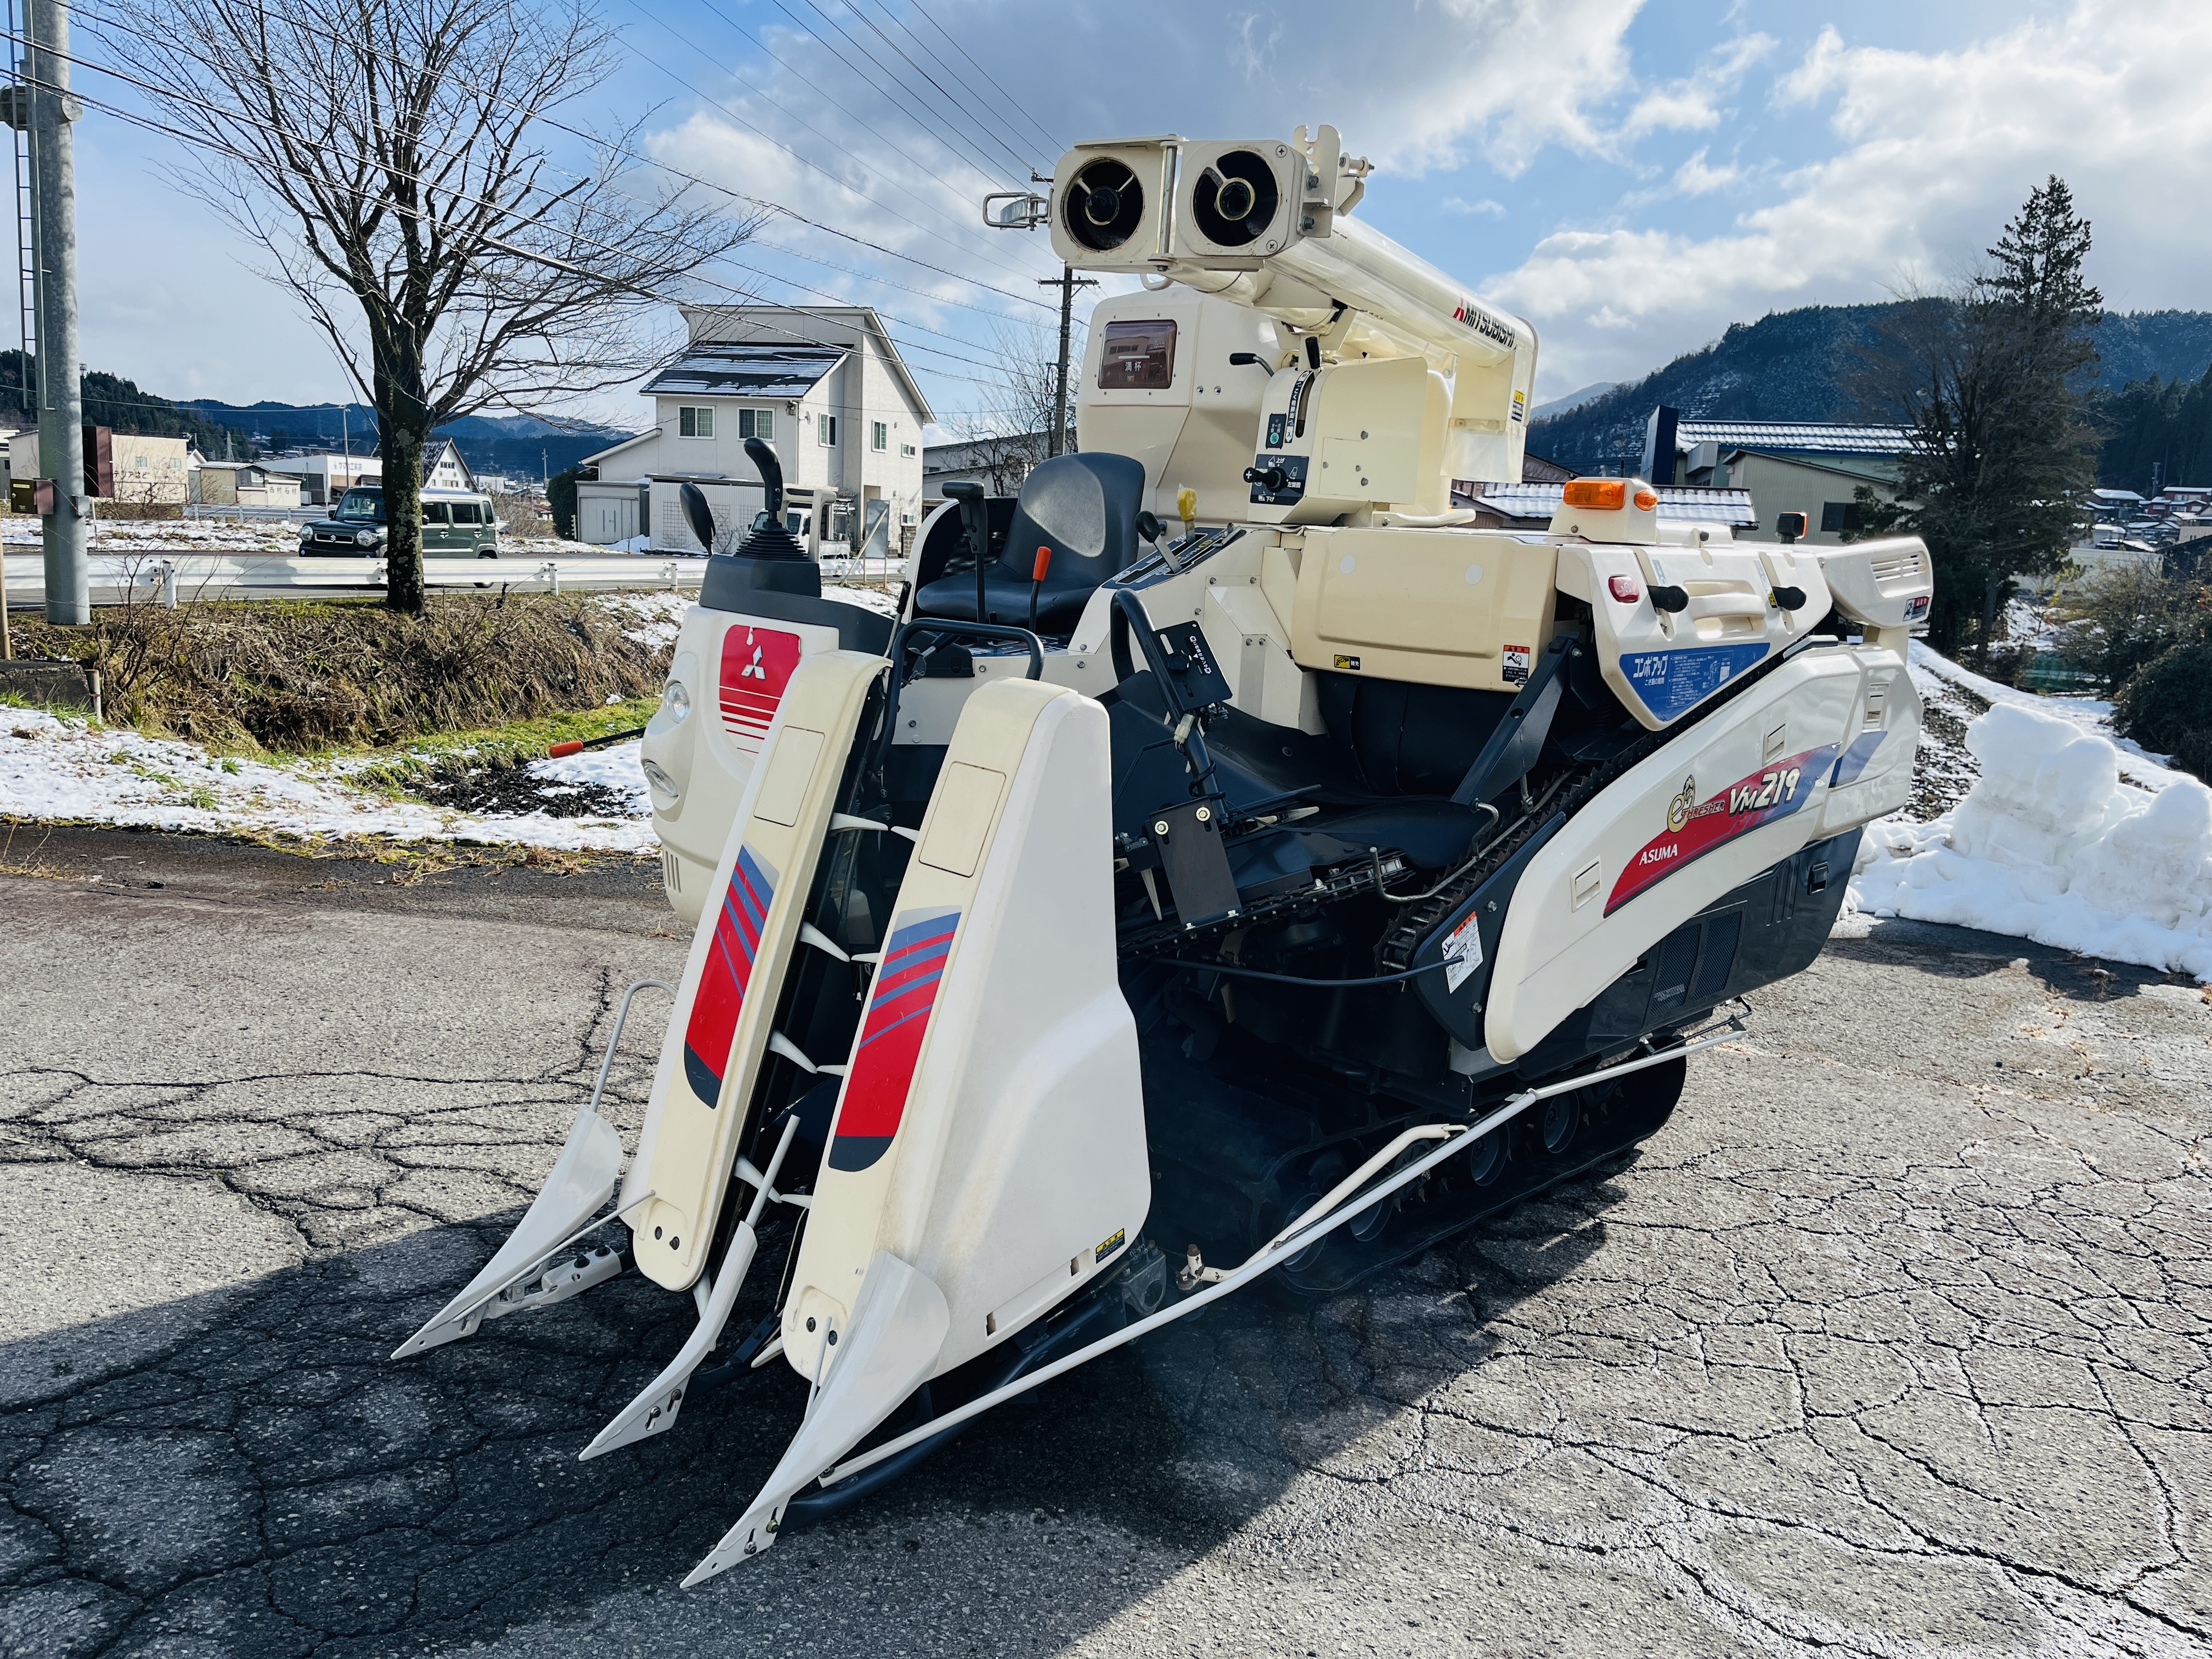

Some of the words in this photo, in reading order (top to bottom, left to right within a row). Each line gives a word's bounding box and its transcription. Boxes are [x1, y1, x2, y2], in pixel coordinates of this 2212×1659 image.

[1463, 301, 1515, 348] MITSUBISHI
[1125, 361, 1142, 372] 満杯
[269, 486, 297, 495] 西村石材
[1681, 799, 1726, 820] THRESHER
[1729, 768, 1801, 816] VM219
[1639, 843, 1678, 866] ASUMA
